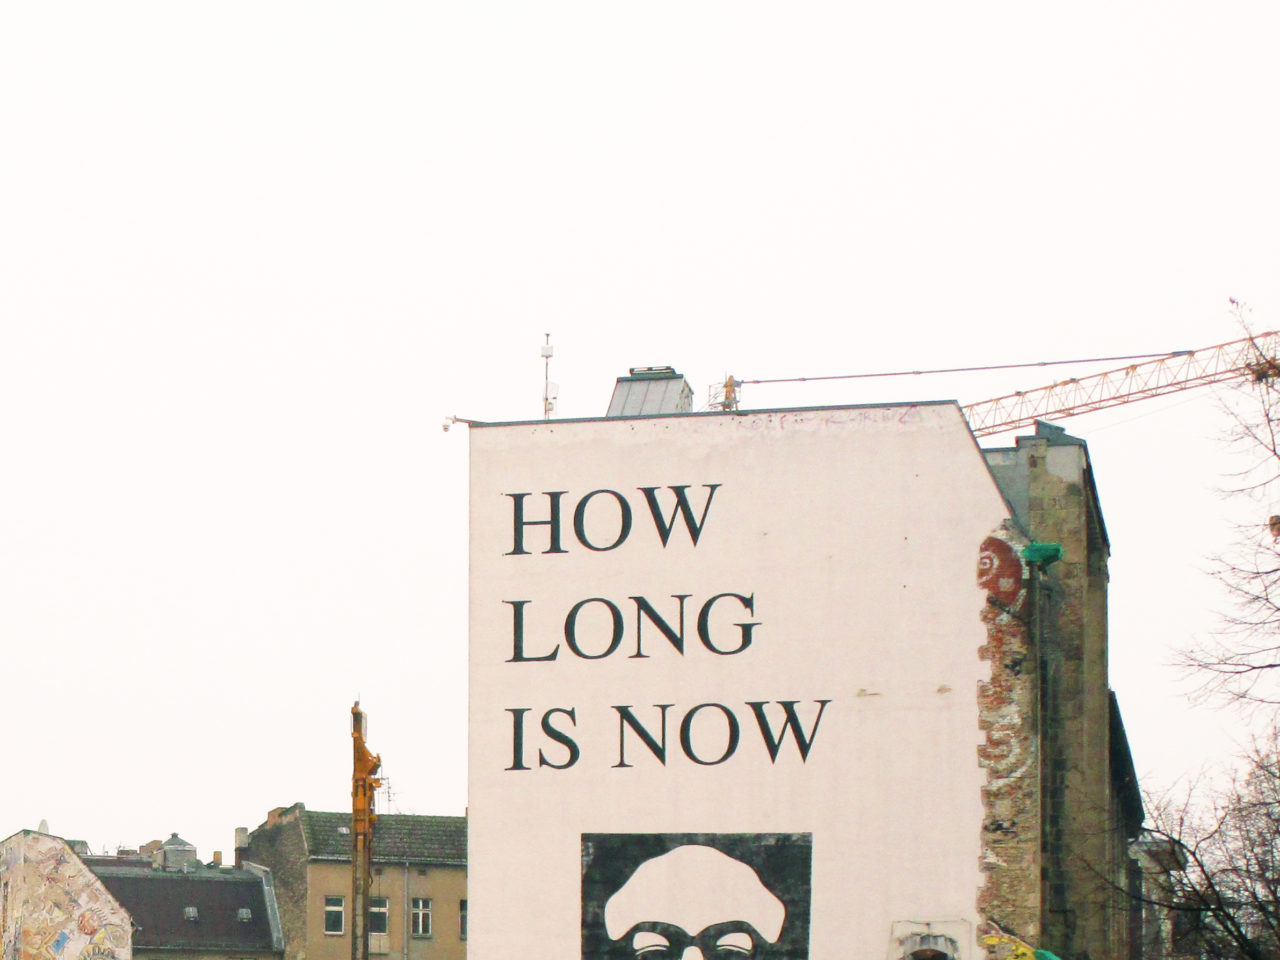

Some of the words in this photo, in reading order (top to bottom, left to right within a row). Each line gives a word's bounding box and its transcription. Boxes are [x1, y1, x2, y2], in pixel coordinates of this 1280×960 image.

[504, 483, 723, 556] HOW
[503, 592, 762, 663] LONG
[504, 706, 581, 771] IS
[610, 699, 832, 768] NOW
